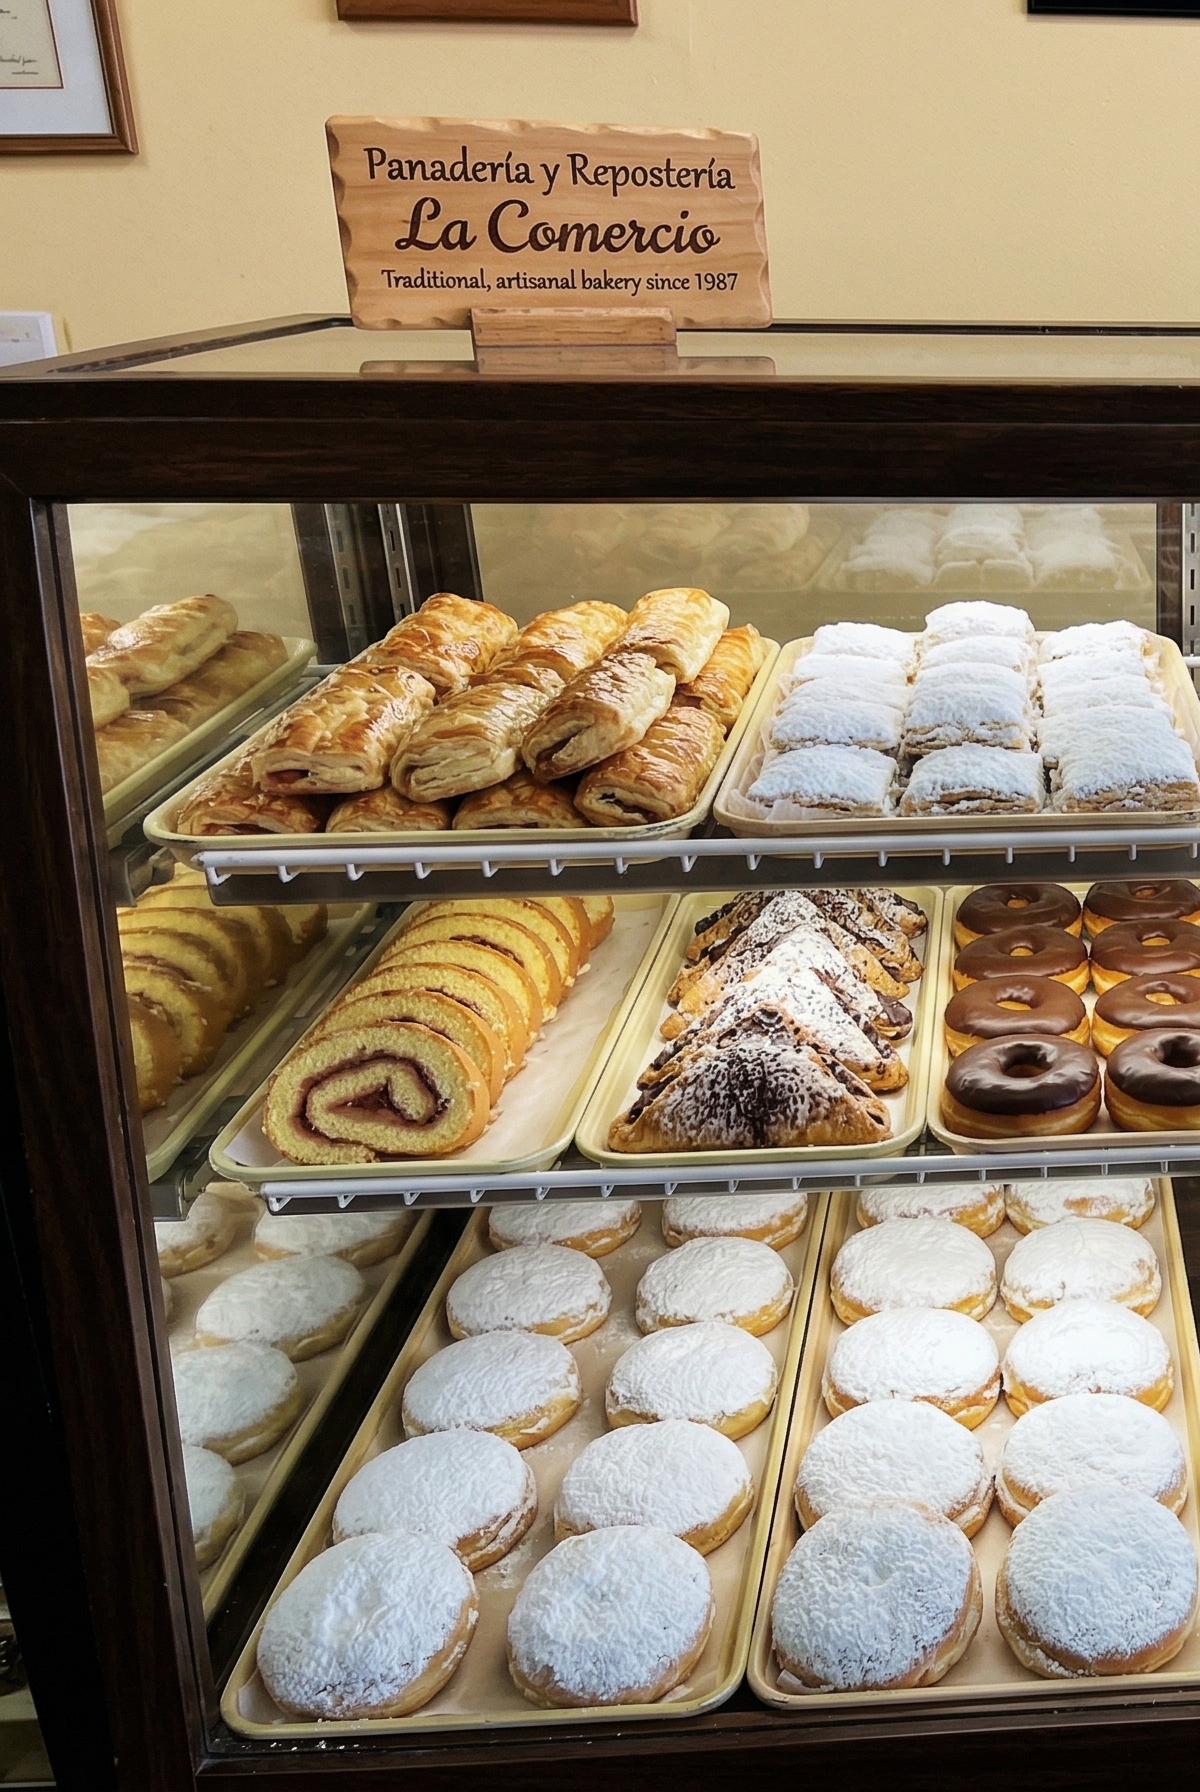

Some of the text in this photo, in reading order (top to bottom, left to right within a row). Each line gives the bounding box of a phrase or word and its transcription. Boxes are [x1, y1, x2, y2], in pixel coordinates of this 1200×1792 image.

[362, 145, 736, 198] Panadería y Repostería
[394, 196, 721, 255] La Comercio
[380, 266, 739, 297] Traditional, artisanal bakery since 1987
